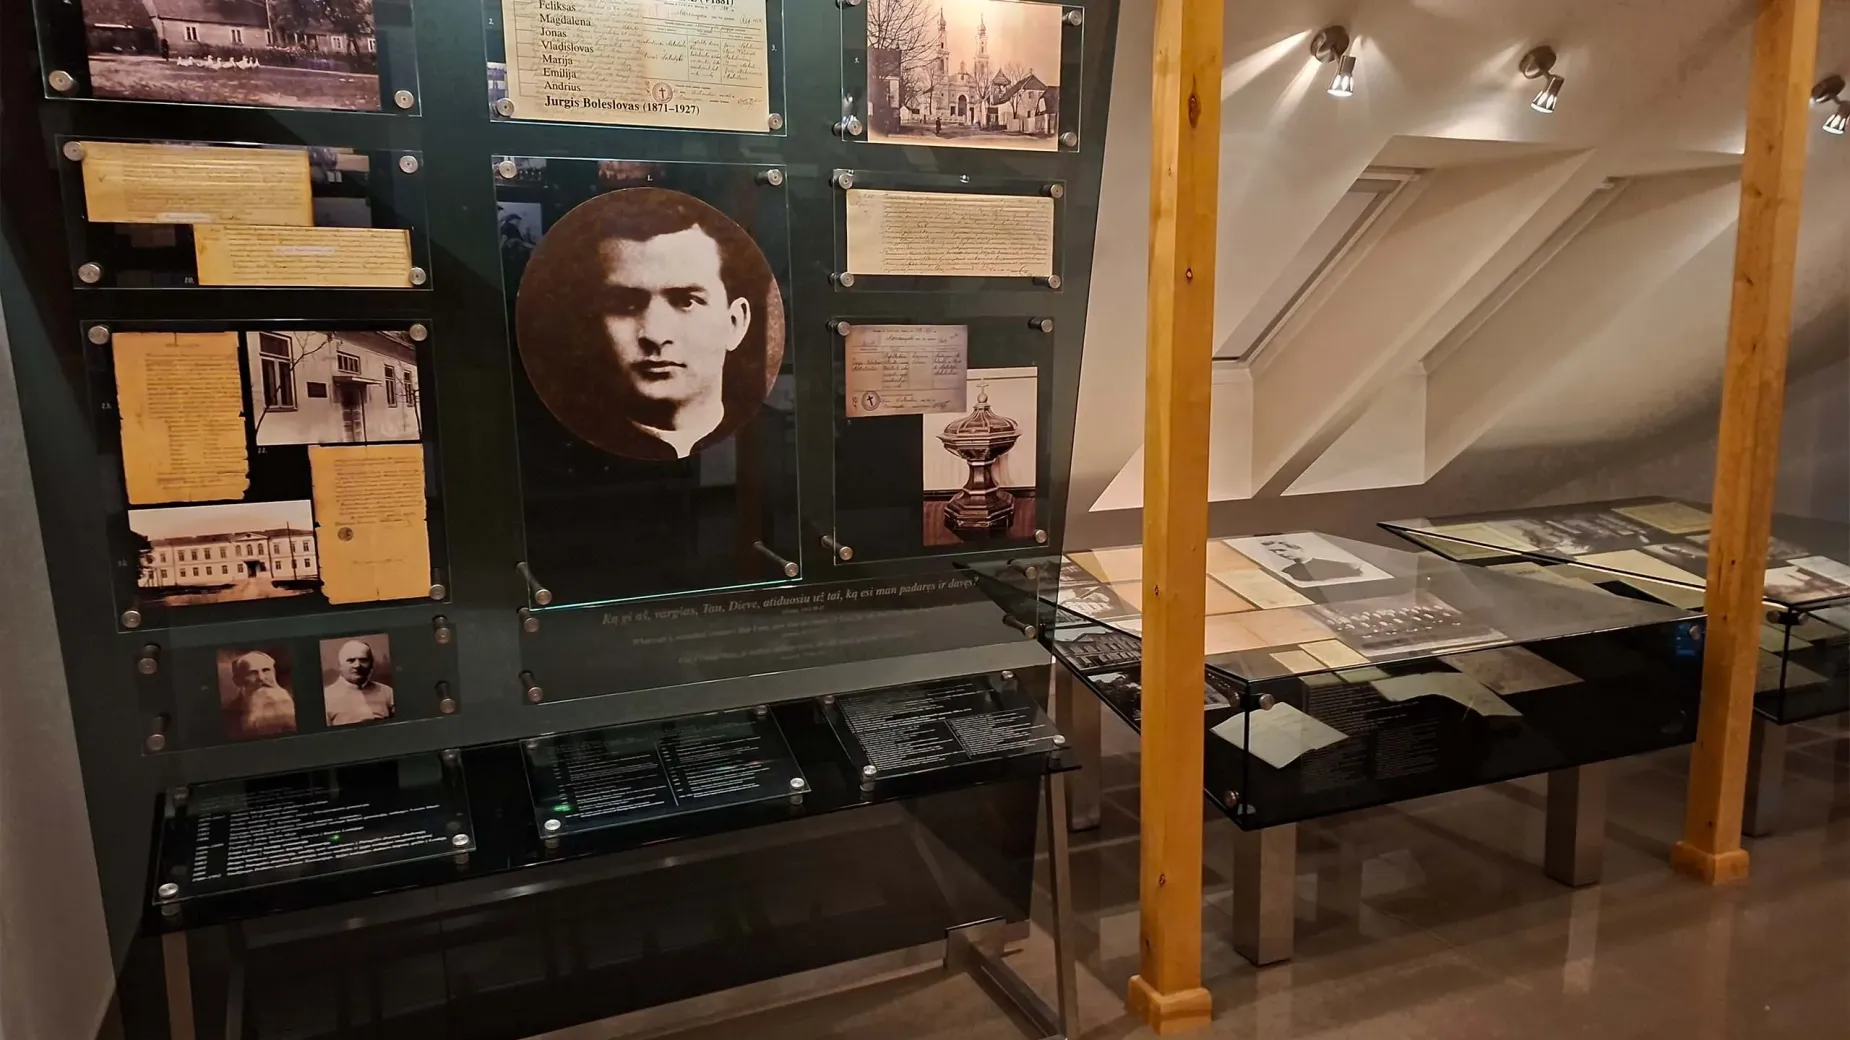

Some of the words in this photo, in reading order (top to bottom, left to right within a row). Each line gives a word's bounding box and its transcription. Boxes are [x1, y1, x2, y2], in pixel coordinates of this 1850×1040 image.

[539, 0, 577, 11] Feliksas
[539, 13, 592, 27] Magdalena
[540, 26, 568, 38] Jonas
[541, 40, 595, 53] Vladislovas
[542, 54, 574, 66] Marija
[543, 67, 577, 80] Emilija
[543, 81, 582, 92] Andrius
[544, 96, 580, 109] Jurgis
[583, 98, 640, 111] Boleslovas
[762, 594, 810, 608] atiduosiu
[812, 591, 825, 603] už
[827, 591, 843, 601] tai,
[860, 586, 874, 597] esi
[875, 587, 897, 596] man
[899, 582, 936, 596] padaręs
[938, 579, 947, 589] ir
[947, 576, 980, 589] davęs?
